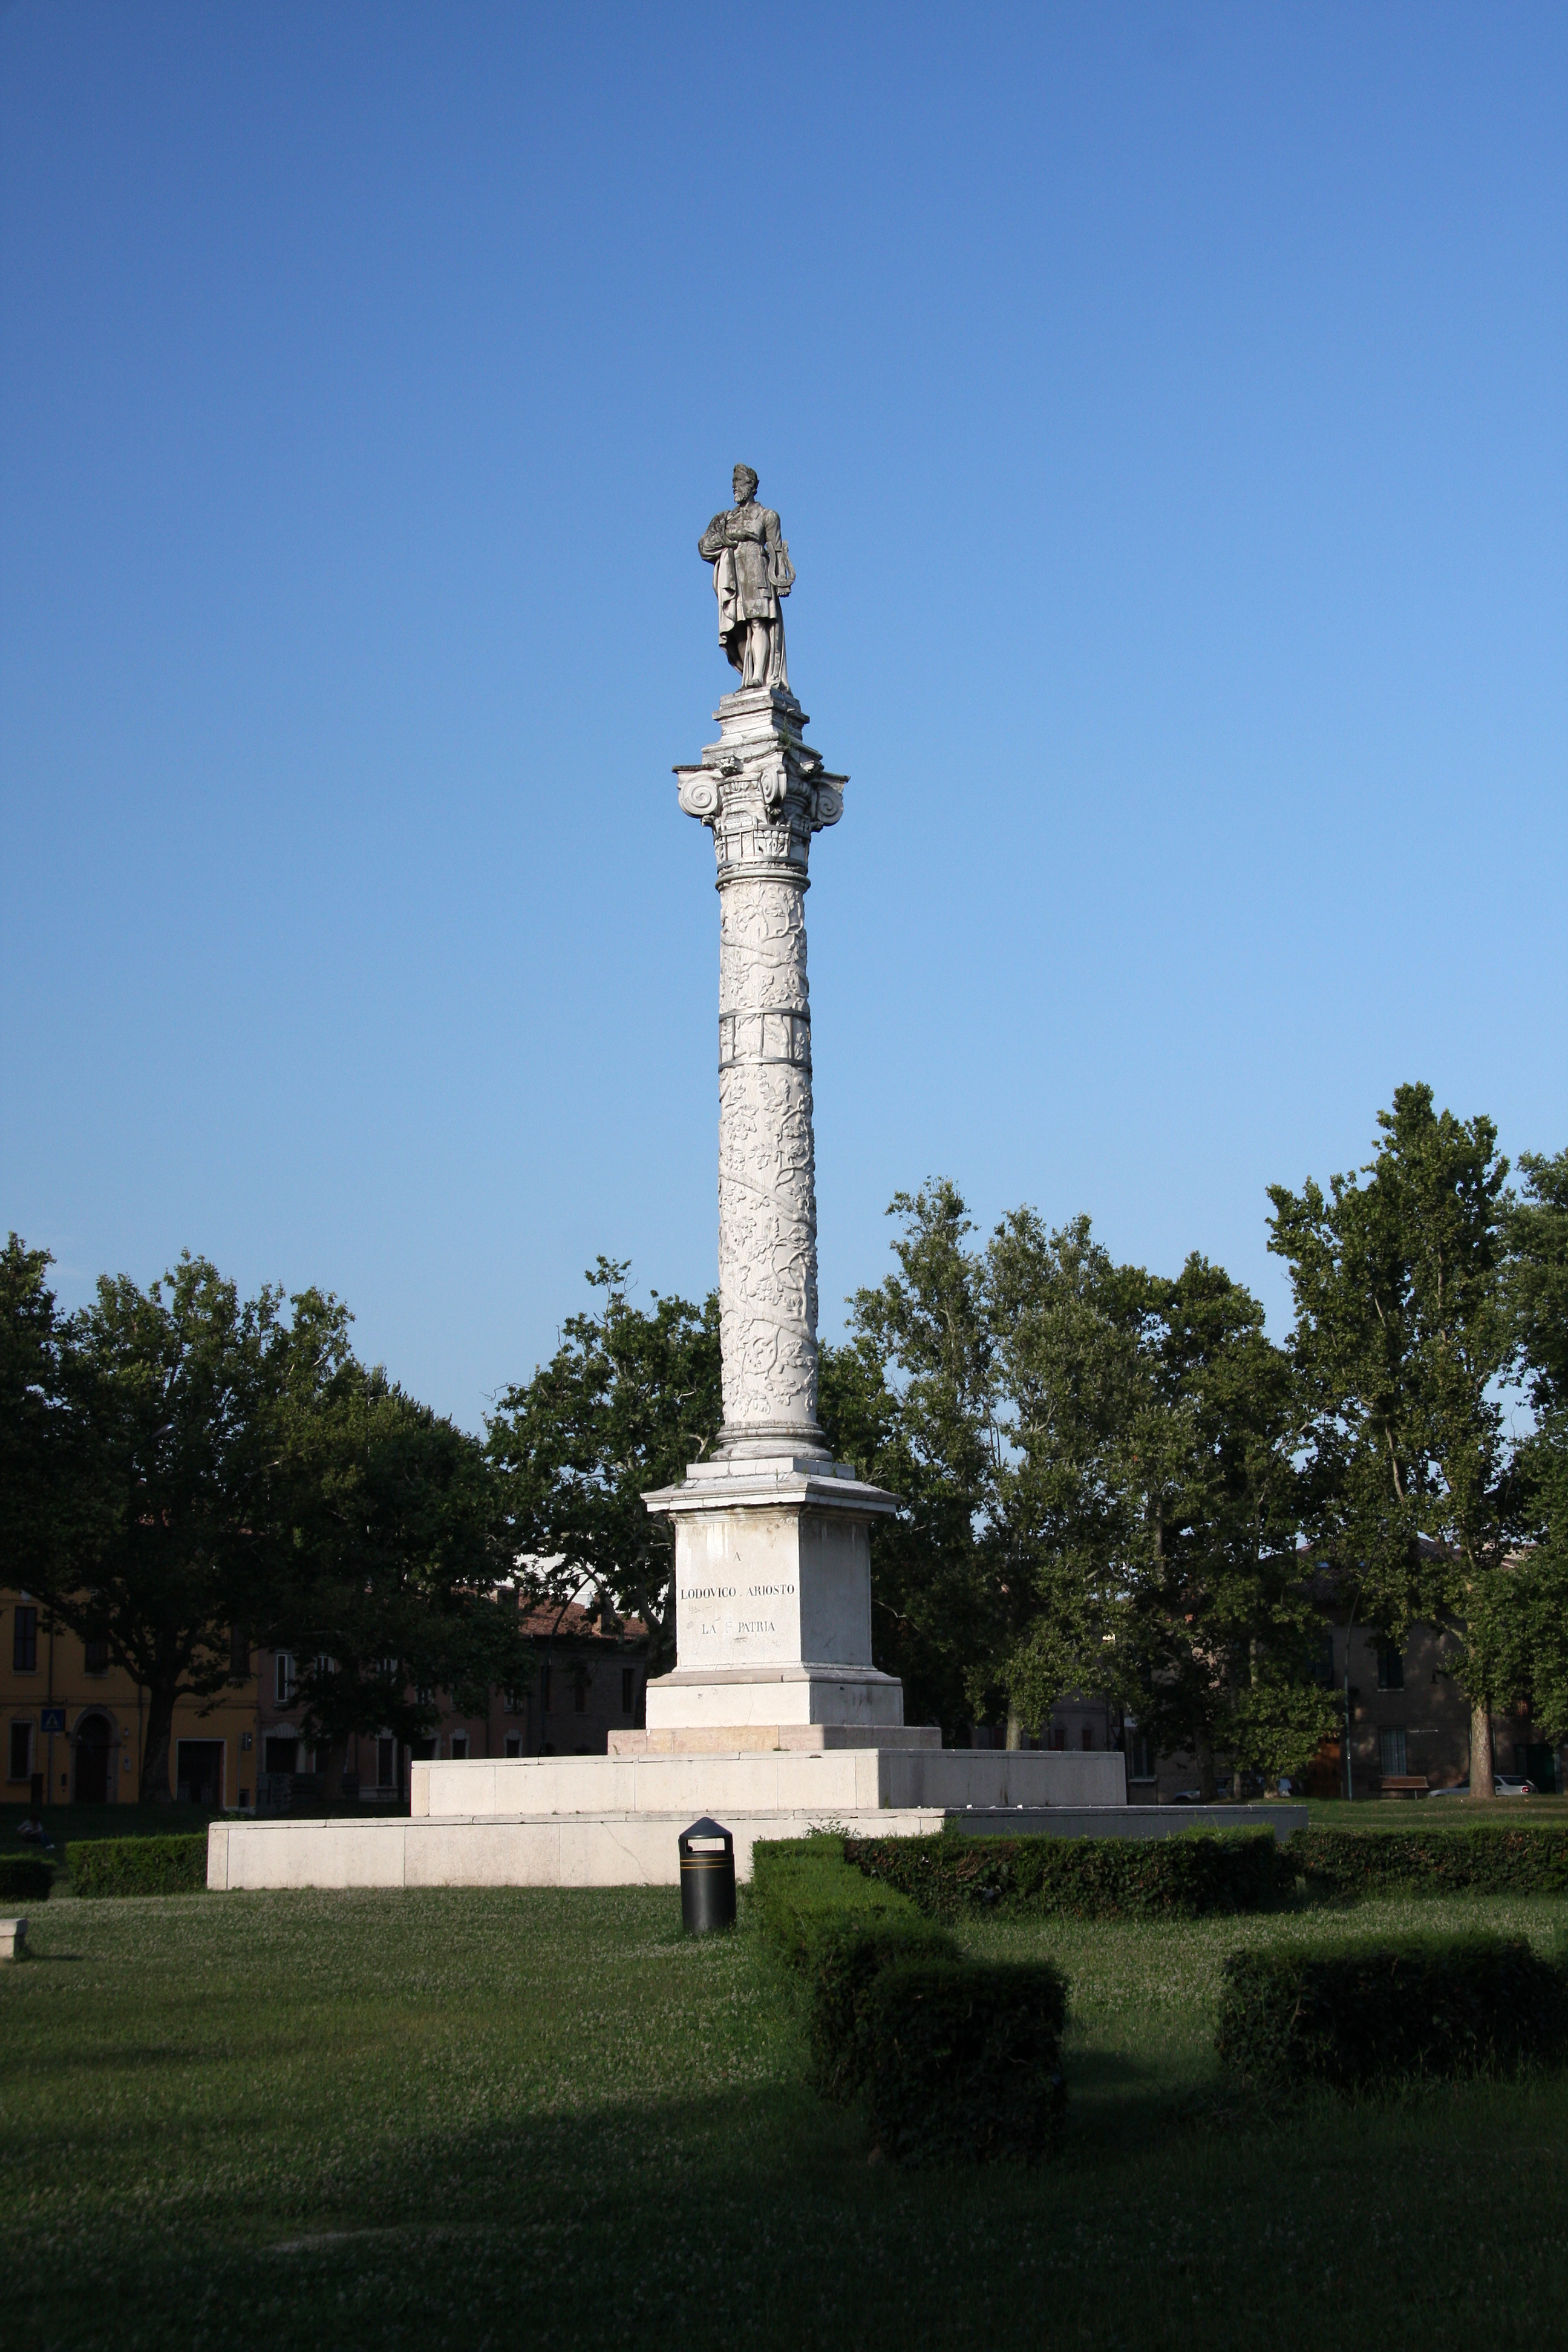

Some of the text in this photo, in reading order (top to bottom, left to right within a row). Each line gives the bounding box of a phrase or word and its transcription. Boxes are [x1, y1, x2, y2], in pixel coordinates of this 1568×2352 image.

[733, 1552, 741, 1562] A
[681, 1584, 795, 1599] LODOVICO ARIOSTO
[702, 1623, 717, 1635] LA
[739, 1621, 776, 1633] PATRIA
